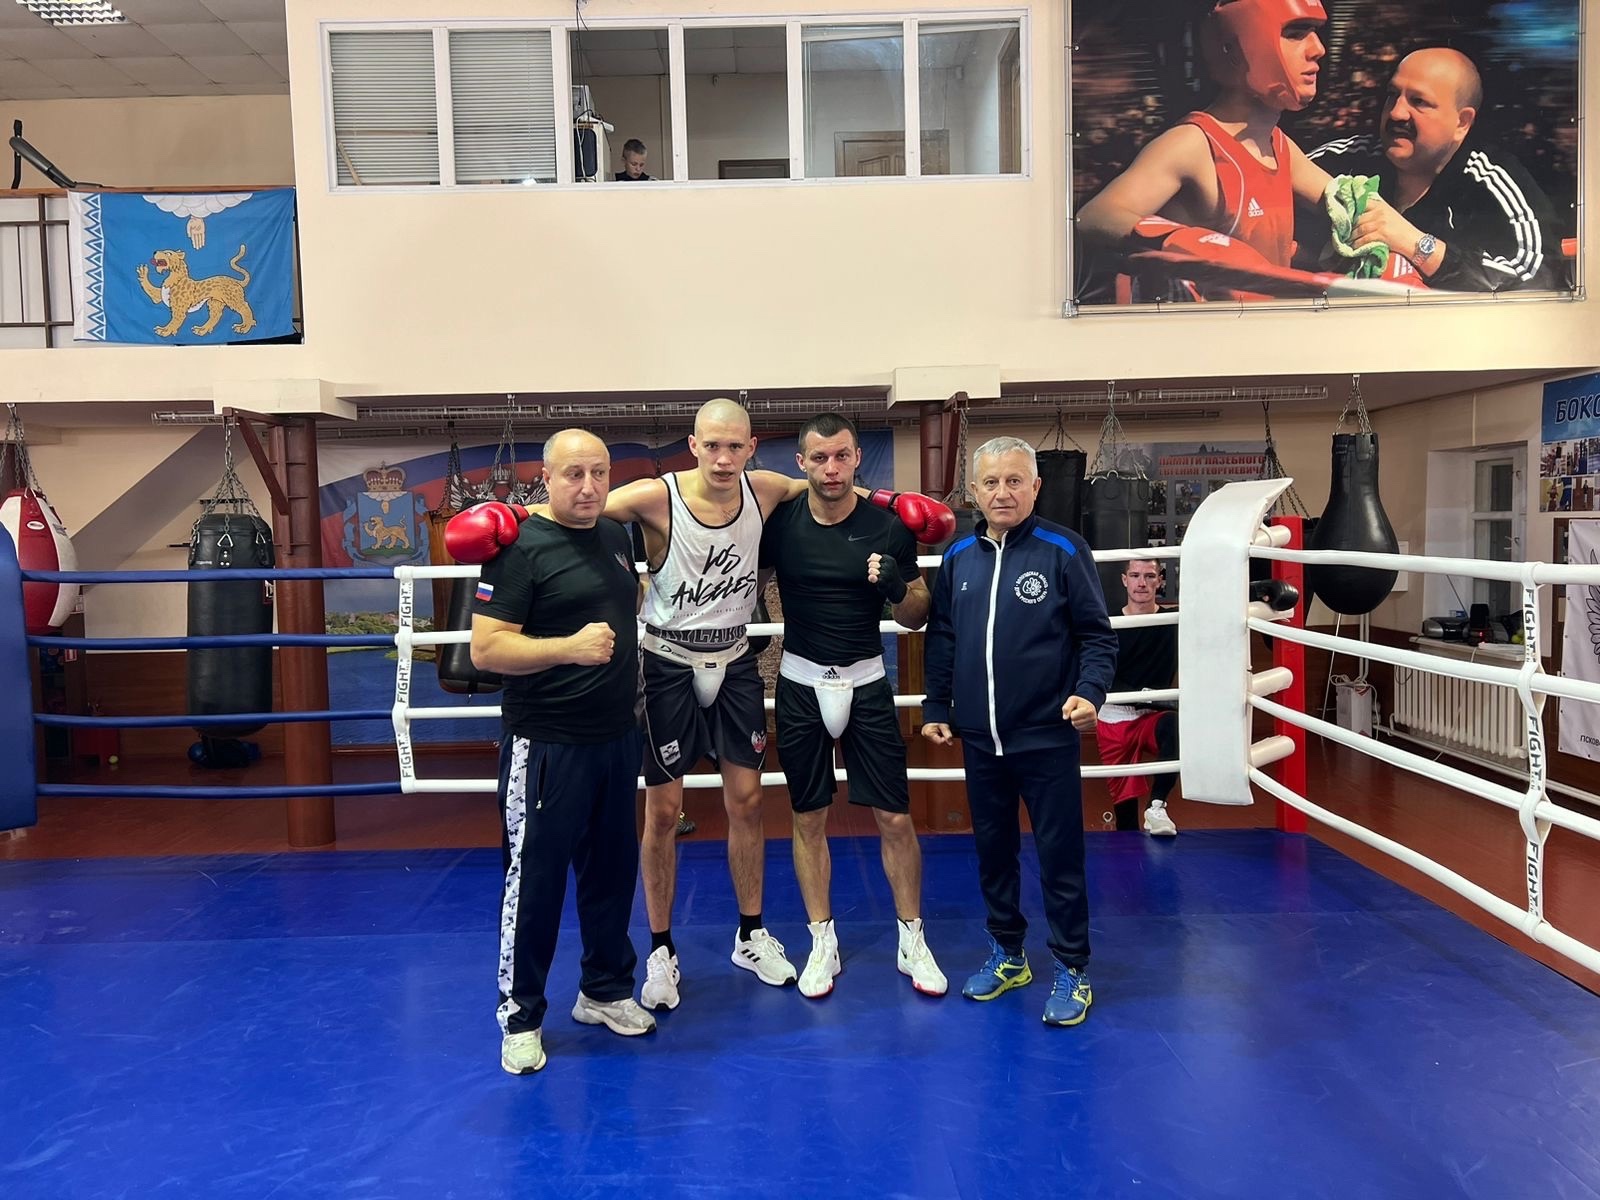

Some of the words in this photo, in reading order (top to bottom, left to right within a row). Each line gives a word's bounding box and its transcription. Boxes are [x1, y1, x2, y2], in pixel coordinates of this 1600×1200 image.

[1160, 456, 1201, 466] ПАМЯТИ
[702, 544, 741, 575] LOS
[401, 588, 412, 628] FIGHT
[670, 571, 756, 610] ANGELES
[1524, 588, 1536, 653] FIGHT
[397, 664, 409, 704] FIGHT
[399, 739, 413, 778] FIGHT
[1528, 715, 1541, 781] FIGHT
[1527, 840, 1539, 907] FIGHT
